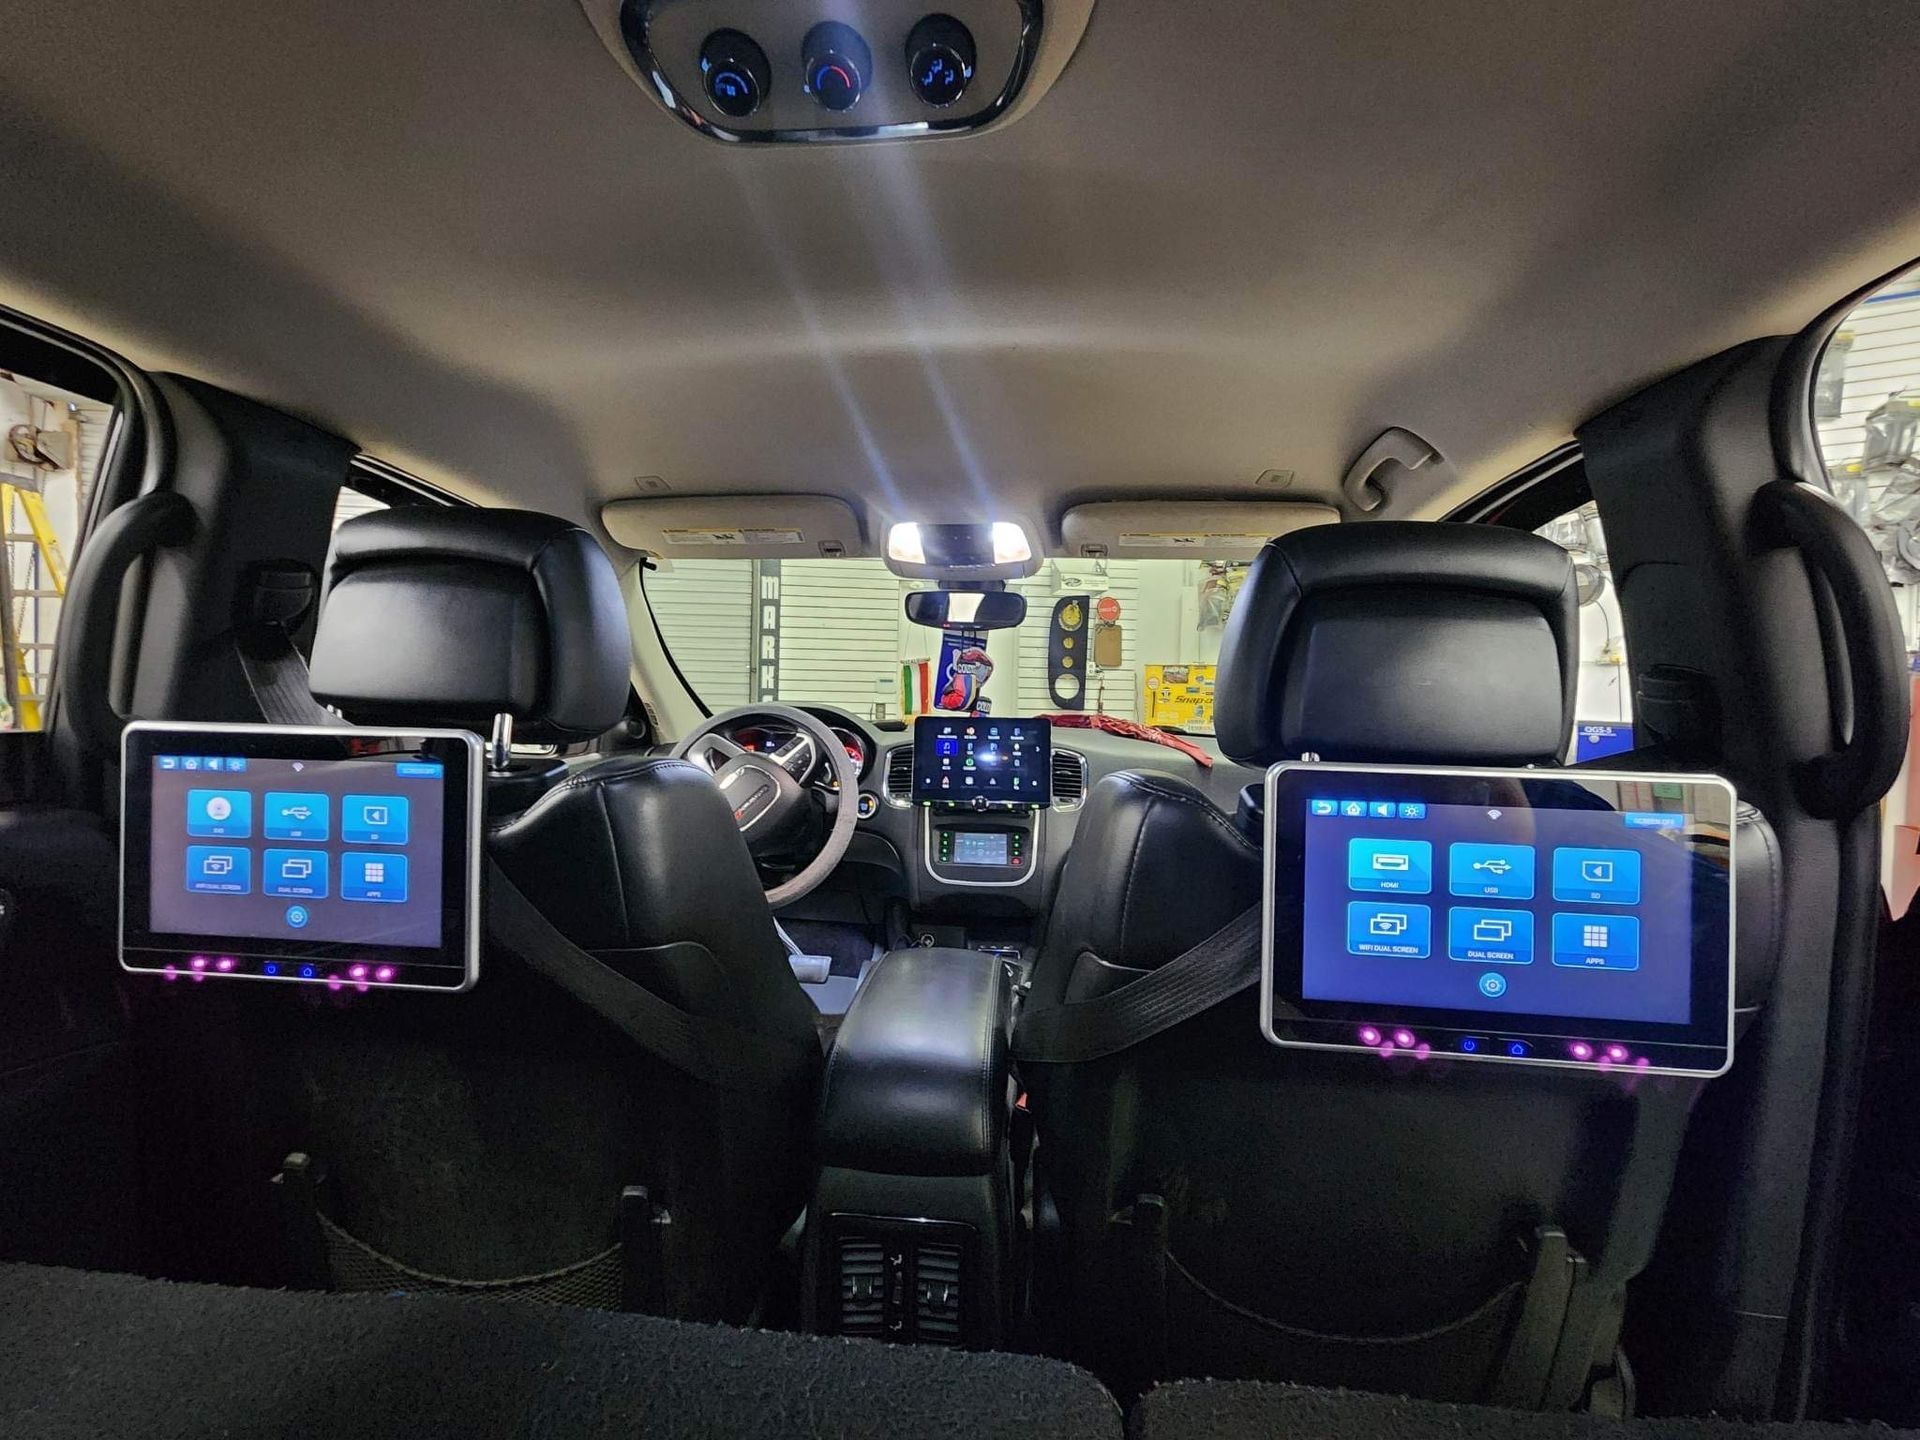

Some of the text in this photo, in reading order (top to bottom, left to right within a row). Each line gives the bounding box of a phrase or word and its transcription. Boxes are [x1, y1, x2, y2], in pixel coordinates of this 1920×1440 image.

[761, 575, 779, 702] MARK
[1175, 695, 1213, 706] Snap-o
[1380, 881, 1399, 889] HDMI
[1484, 886, 1499, 894] USB
[1374, 944, 1391, 952] DUAL
[1392, 945, 1418, 954] SCREEN
[1468, 950, 1514, 960] DUAL SCREEN
[1585, 957, 1605, 965] APPS
